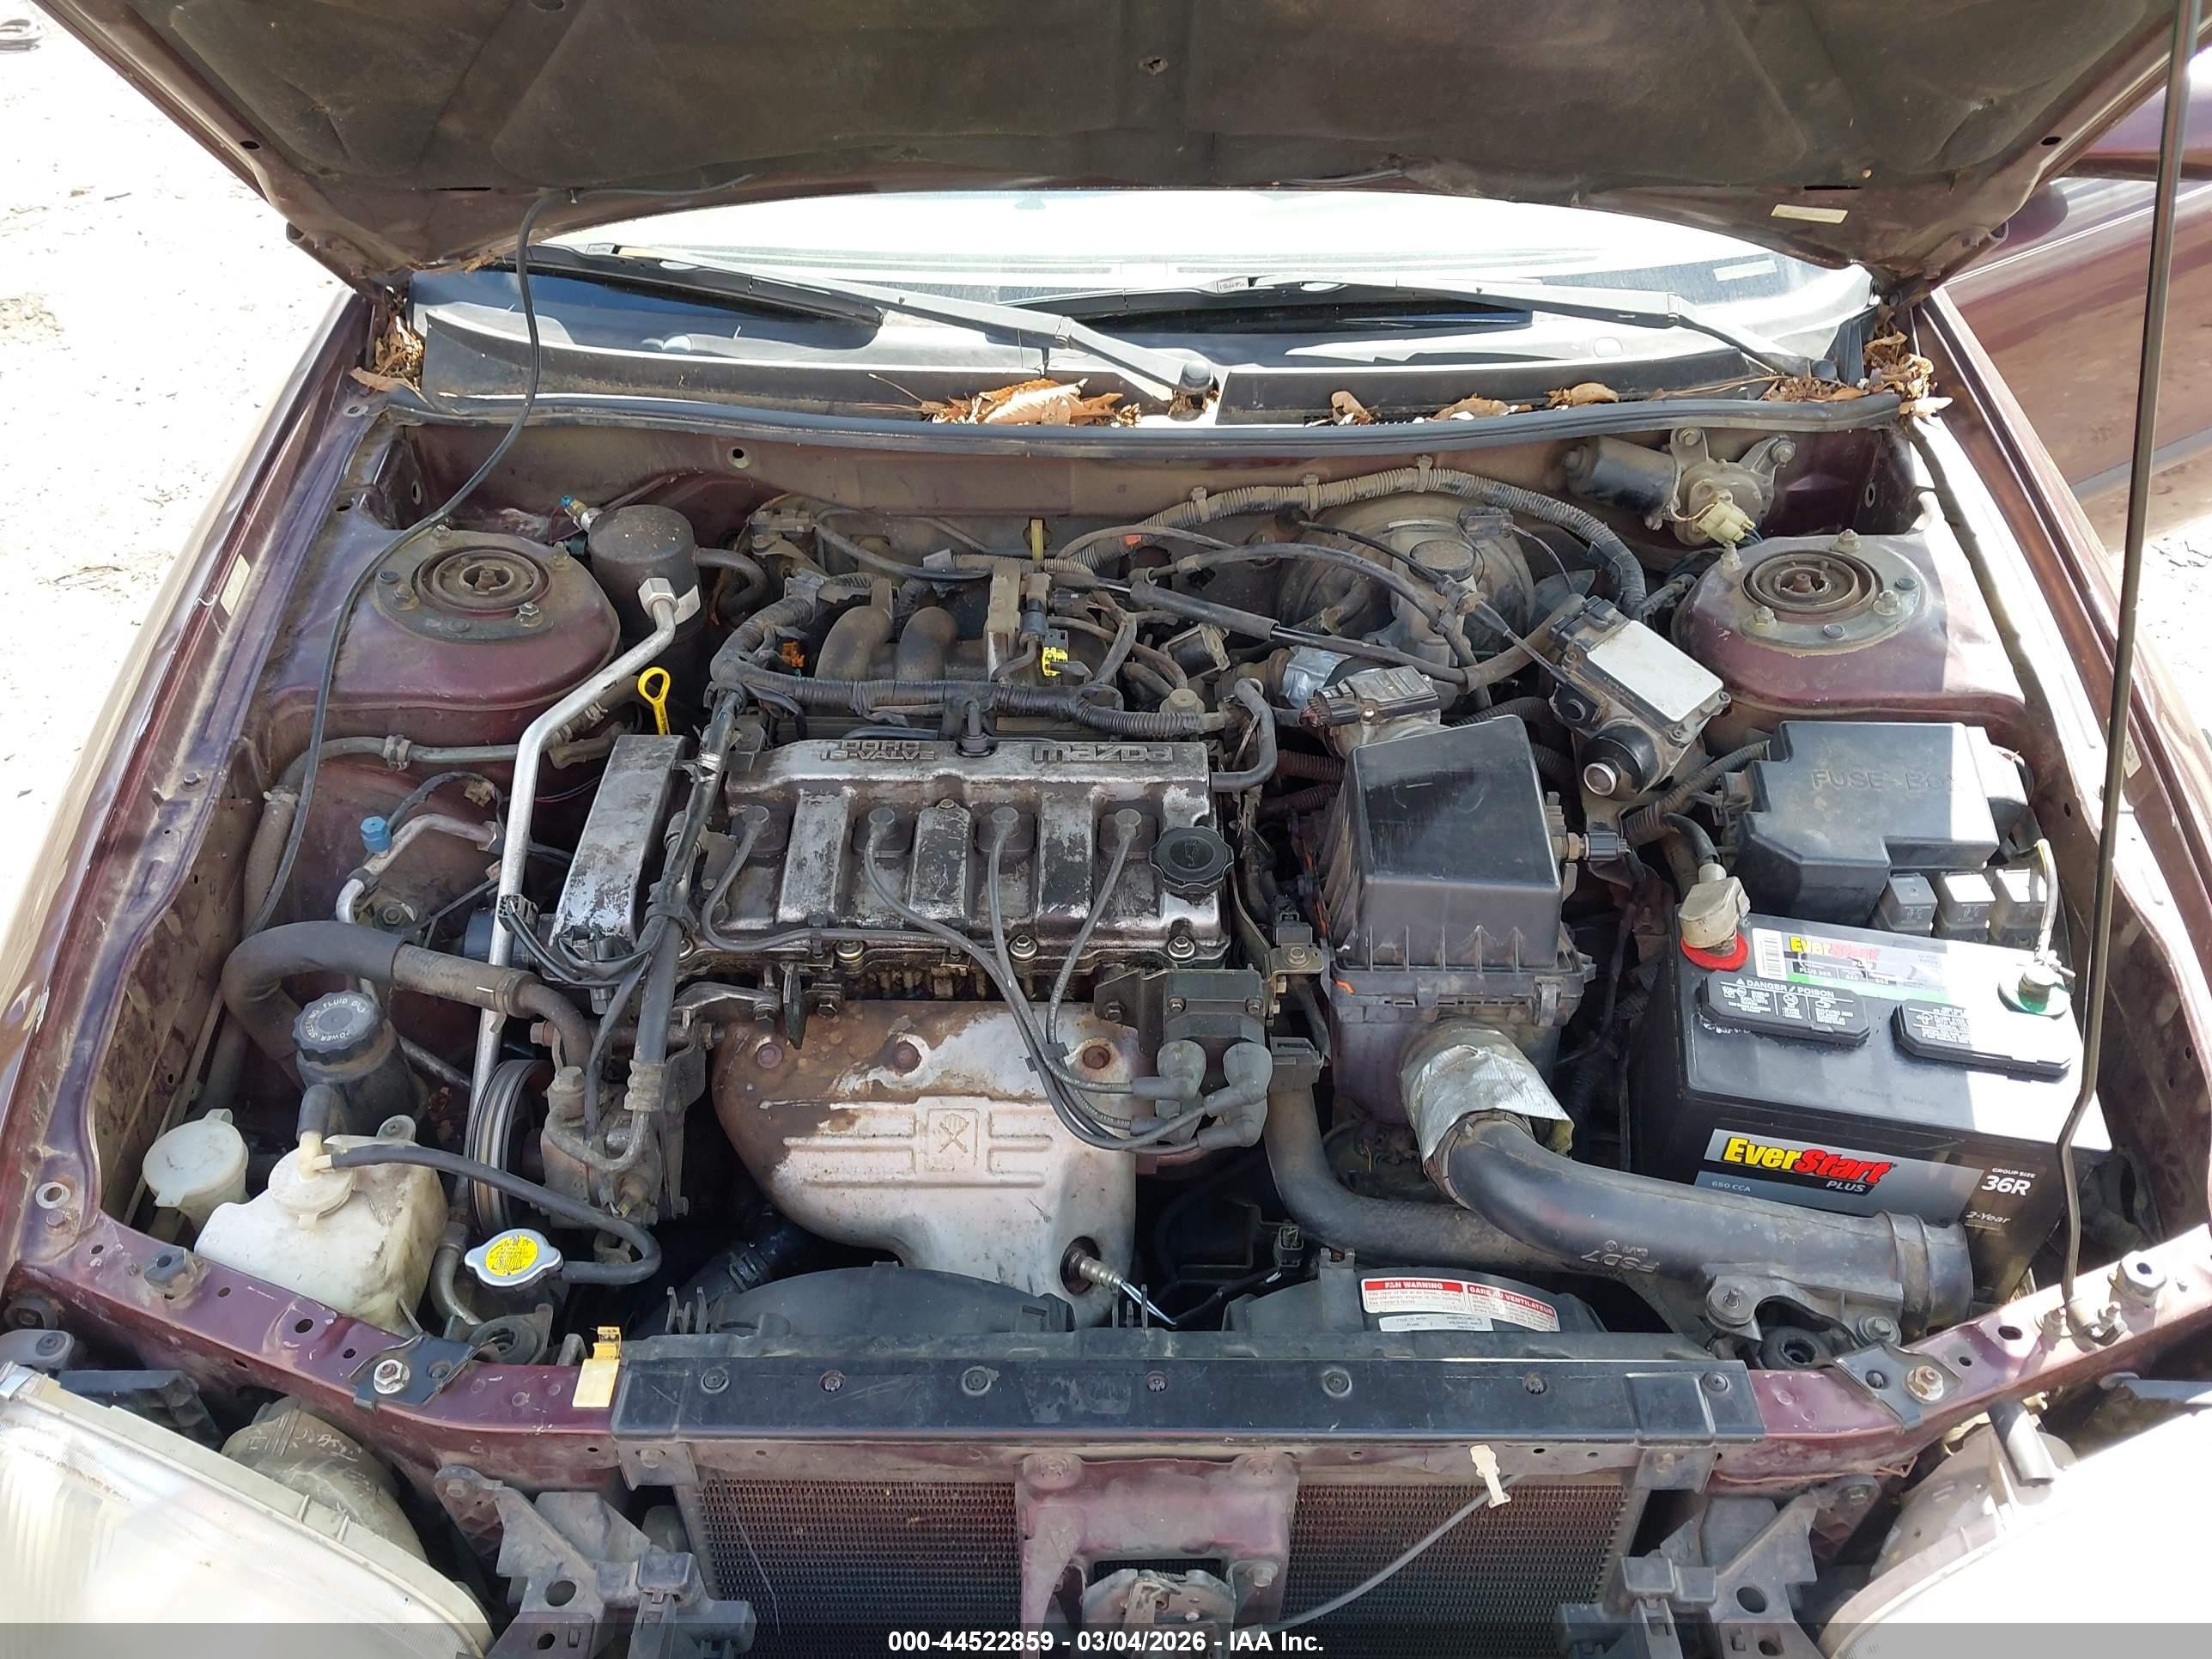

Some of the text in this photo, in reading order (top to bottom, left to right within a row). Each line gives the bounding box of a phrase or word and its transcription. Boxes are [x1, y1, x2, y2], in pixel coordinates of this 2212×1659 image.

[1746, 979, 1788, 993] DANGER
[1797, 987, 1835, 998] POISON
[322, 997, 348, 1009] FLUID
[1723, 1136, 1893, 1184] EverStart
[1992, 1168, 2019, 1176] GROUP
[1732, 1184, 1753, 1193] CCA
[1826, 1180, 1867, 1194] PLUS
[1981, 1175, 2032, 1196] 36R
[1966, 1211, 2011, 1224] 2-Year
[1403, 1281, 1443, 1290] WARNING
[1469, 1285, 1491, 1297] GARE
[1505, 1294, 1554, 1316] VENTILATEUR
